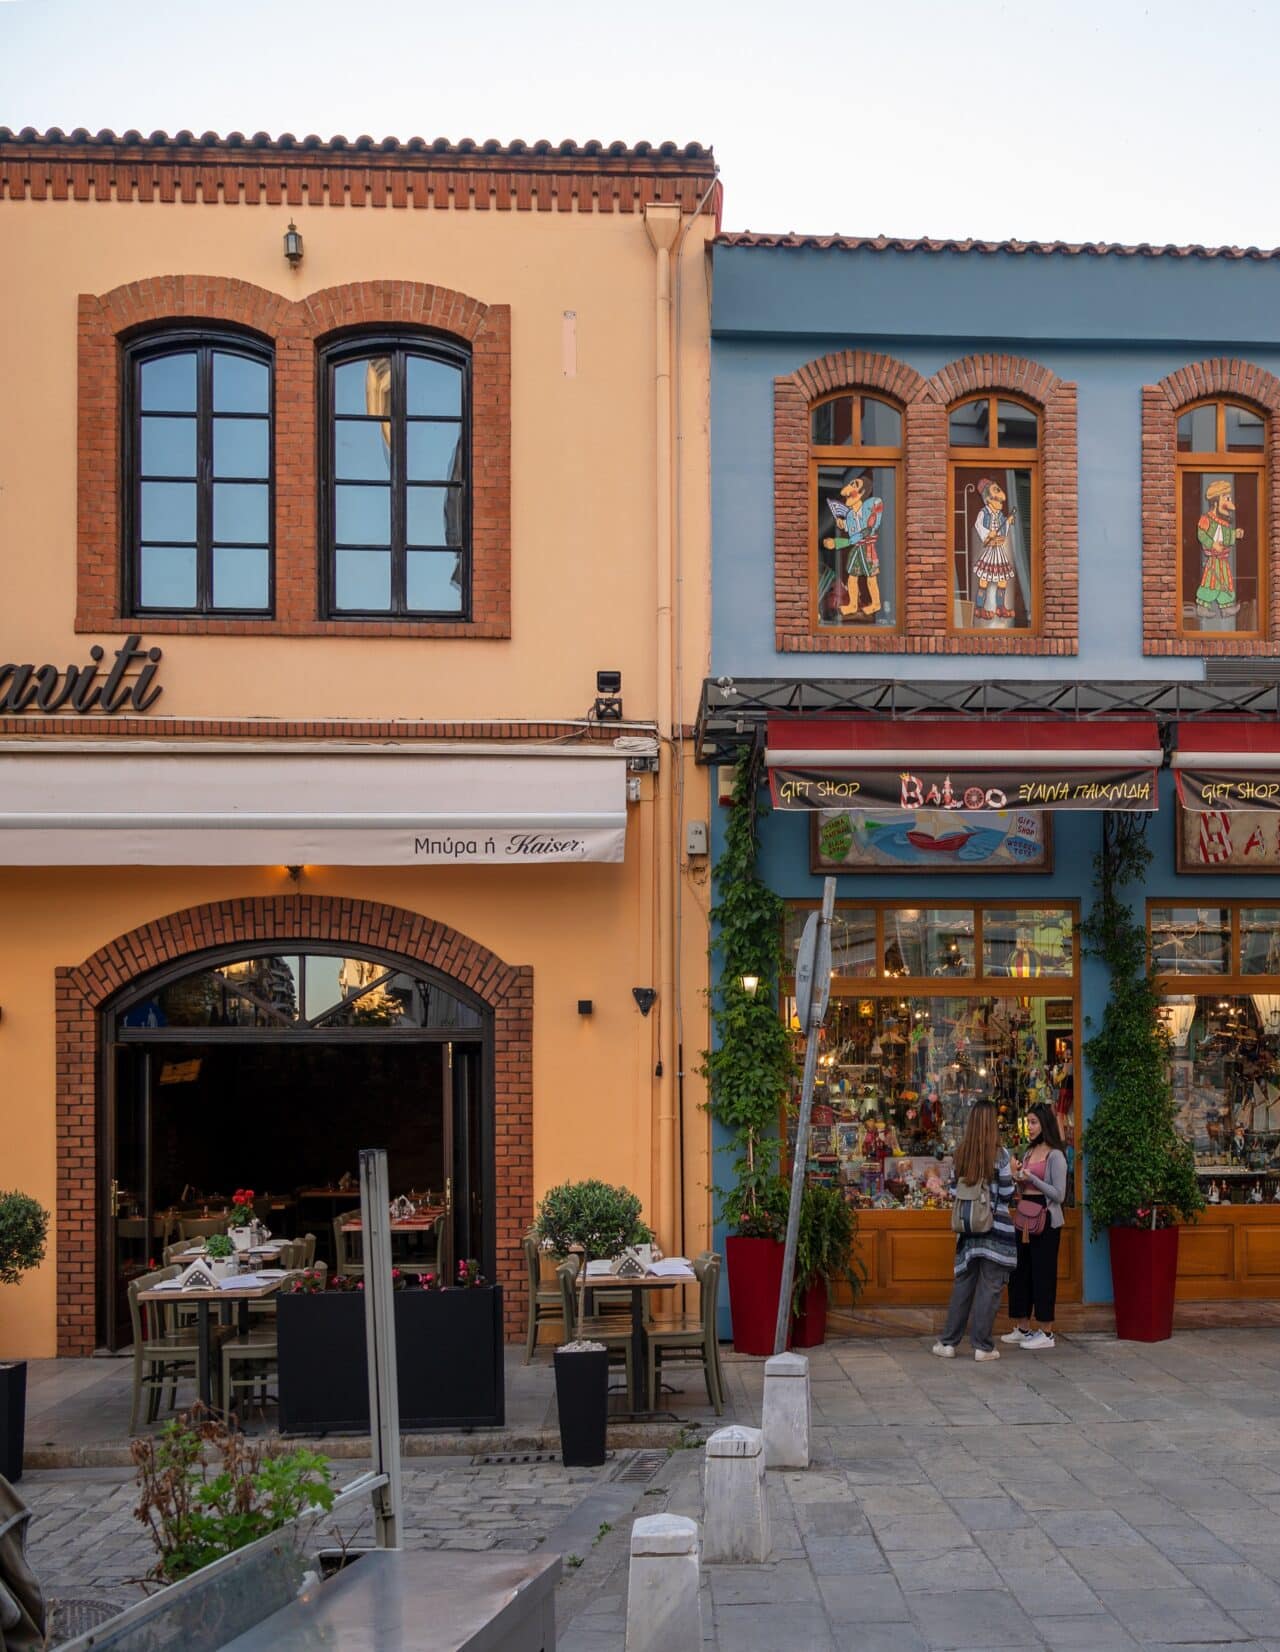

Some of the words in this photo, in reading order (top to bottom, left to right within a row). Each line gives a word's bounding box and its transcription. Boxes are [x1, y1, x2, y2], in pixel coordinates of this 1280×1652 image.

[780, 781, 814, 804] GIFT
[816, 782, 860, 797] SHOP
[1018, 782, 1069, 803] ΞΥΛΙΝΑ
[1073, 783, 1151, 801] ΠΑΙΧΝΙΔΙΑ
[1201, 783, 1234, 804] GIFT
[1237, 782, 1280, 799] SHOP
[1017, 825, 1035, 836] SHOP
[1018, 816, 1036, 829] GIFT
[415, 837, 477, 857] Μπύρα
[485, 836, 496, 854] ή
